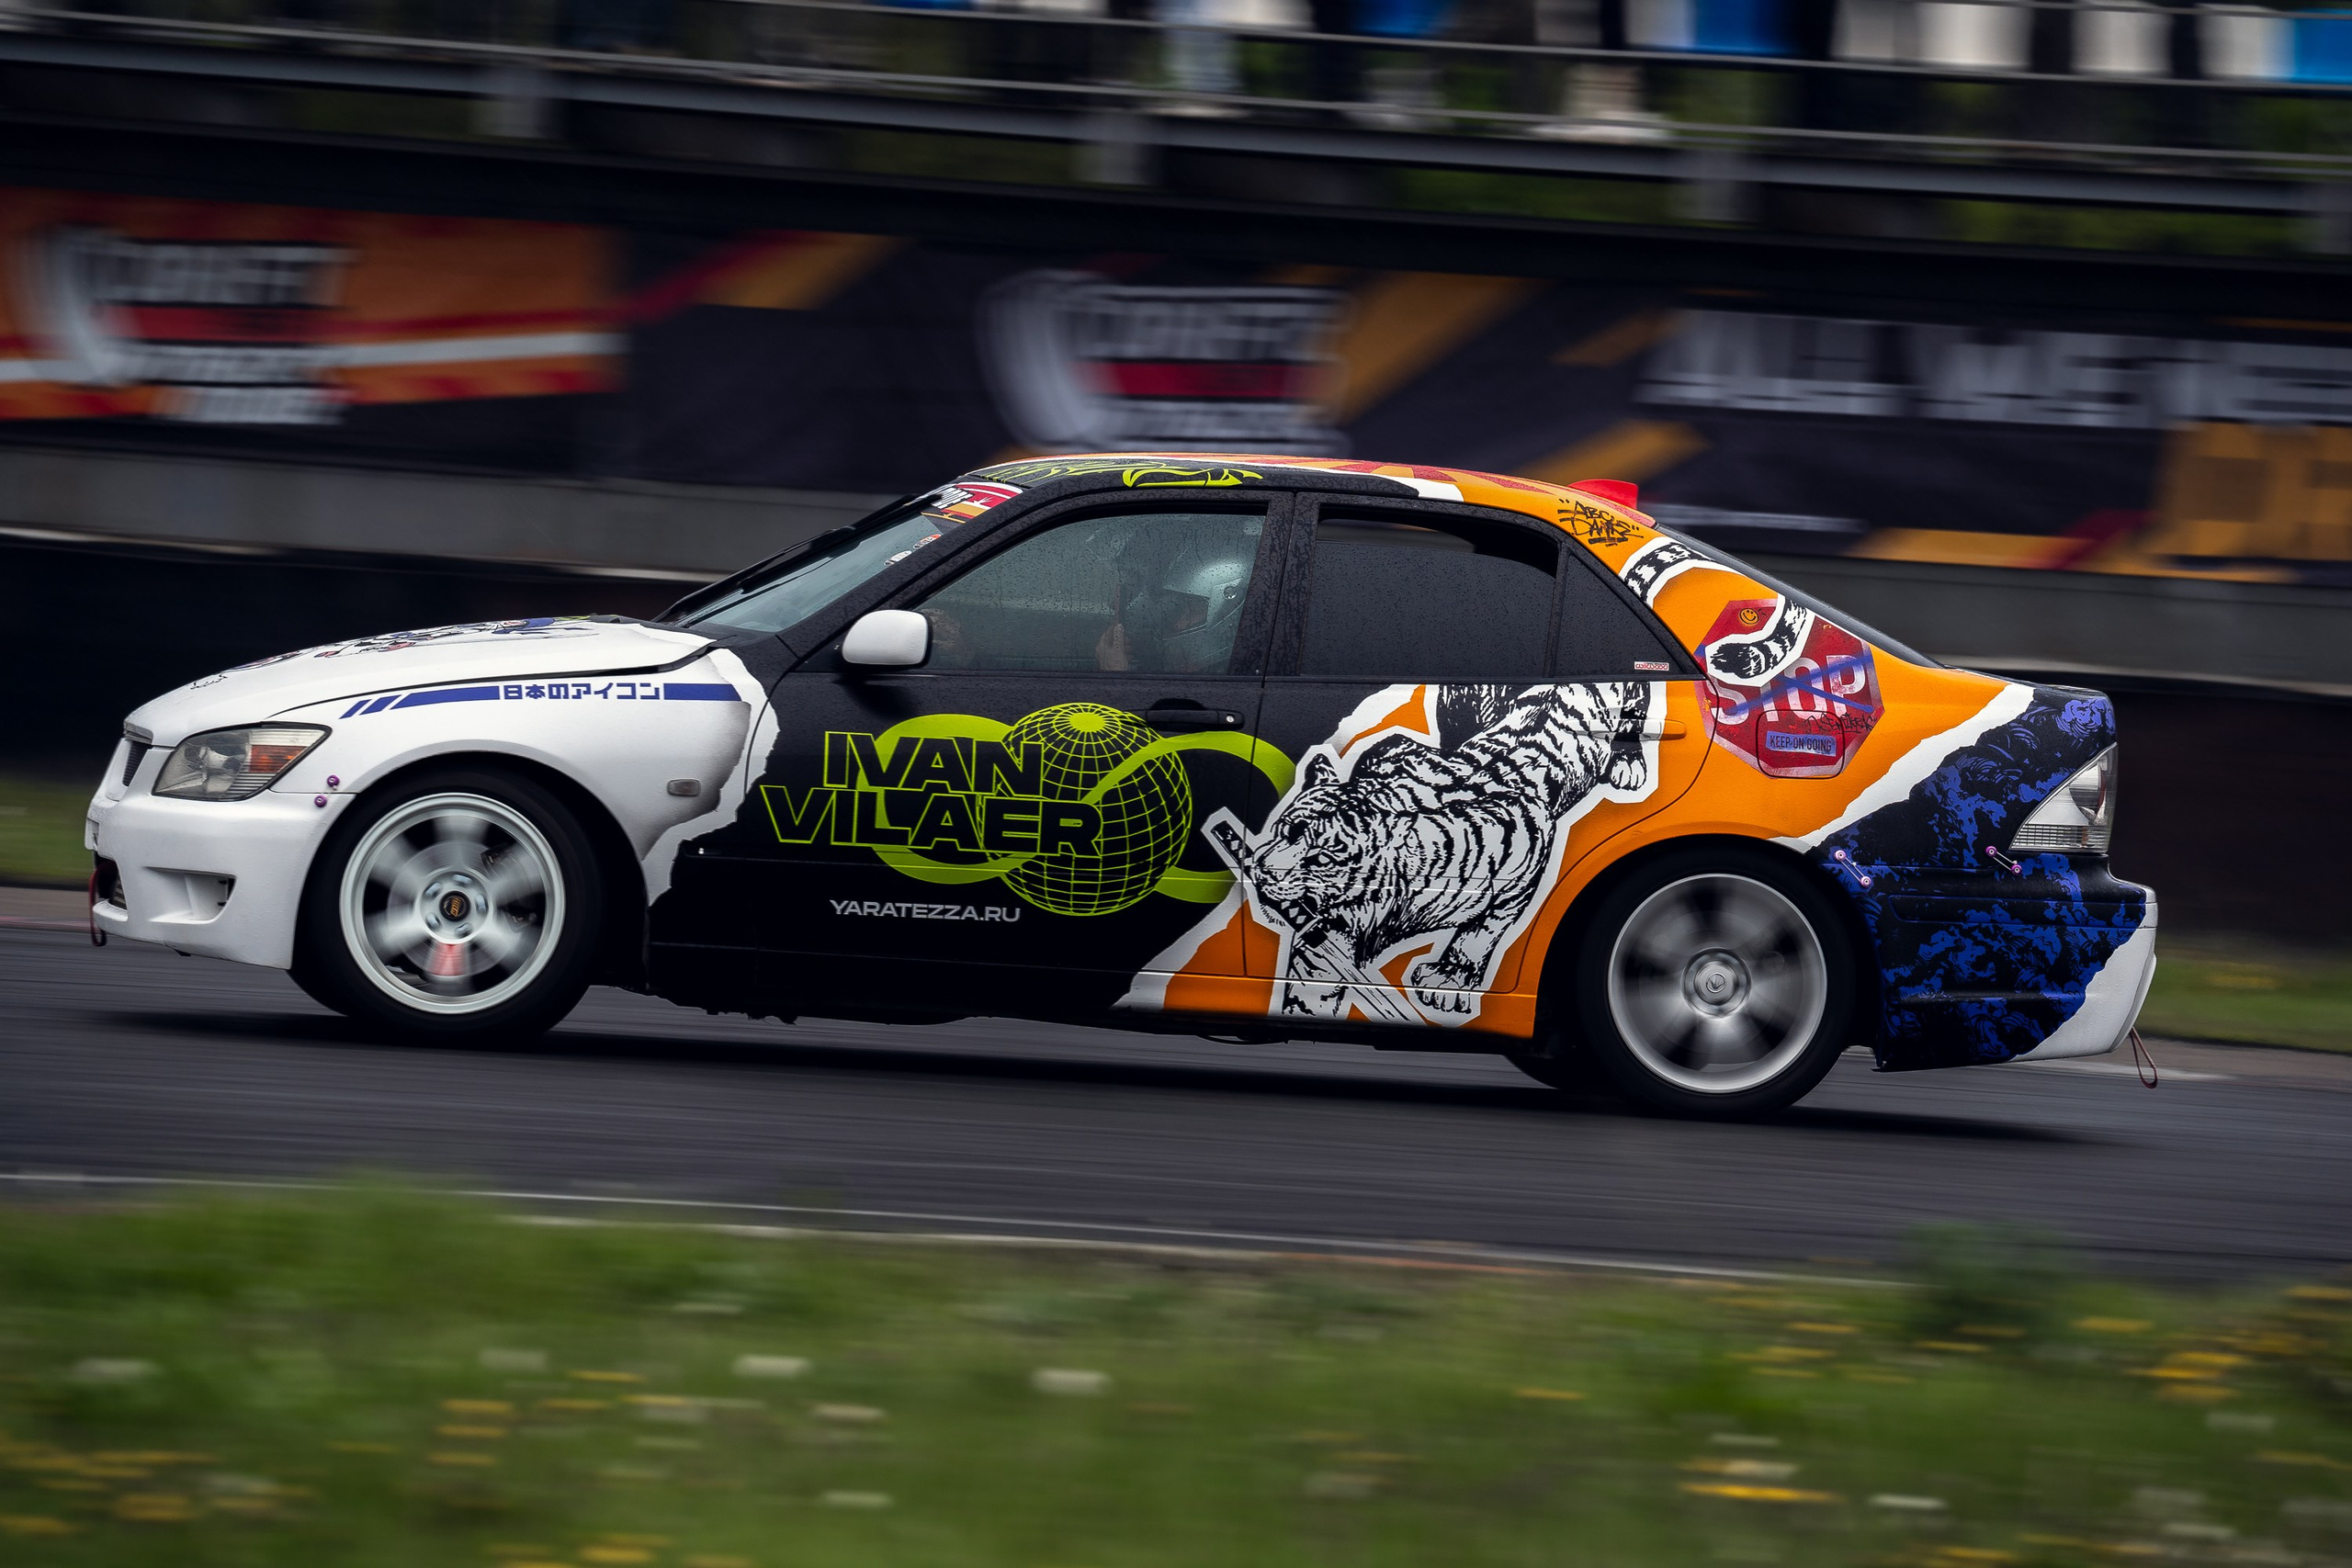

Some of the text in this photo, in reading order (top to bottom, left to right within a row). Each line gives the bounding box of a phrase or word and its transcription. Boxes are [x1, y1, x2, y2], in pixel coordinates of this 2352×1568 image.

[503, 682, 660, 700] 日本のアイコン
[1770, 735, 1832, 752] KEEP ON GOING
[823, 731, 1044, 798] IVAN
[759, 784, 1103, 858] VILAER
[829, 899, 1022, 922] YARATEZZA.RU
